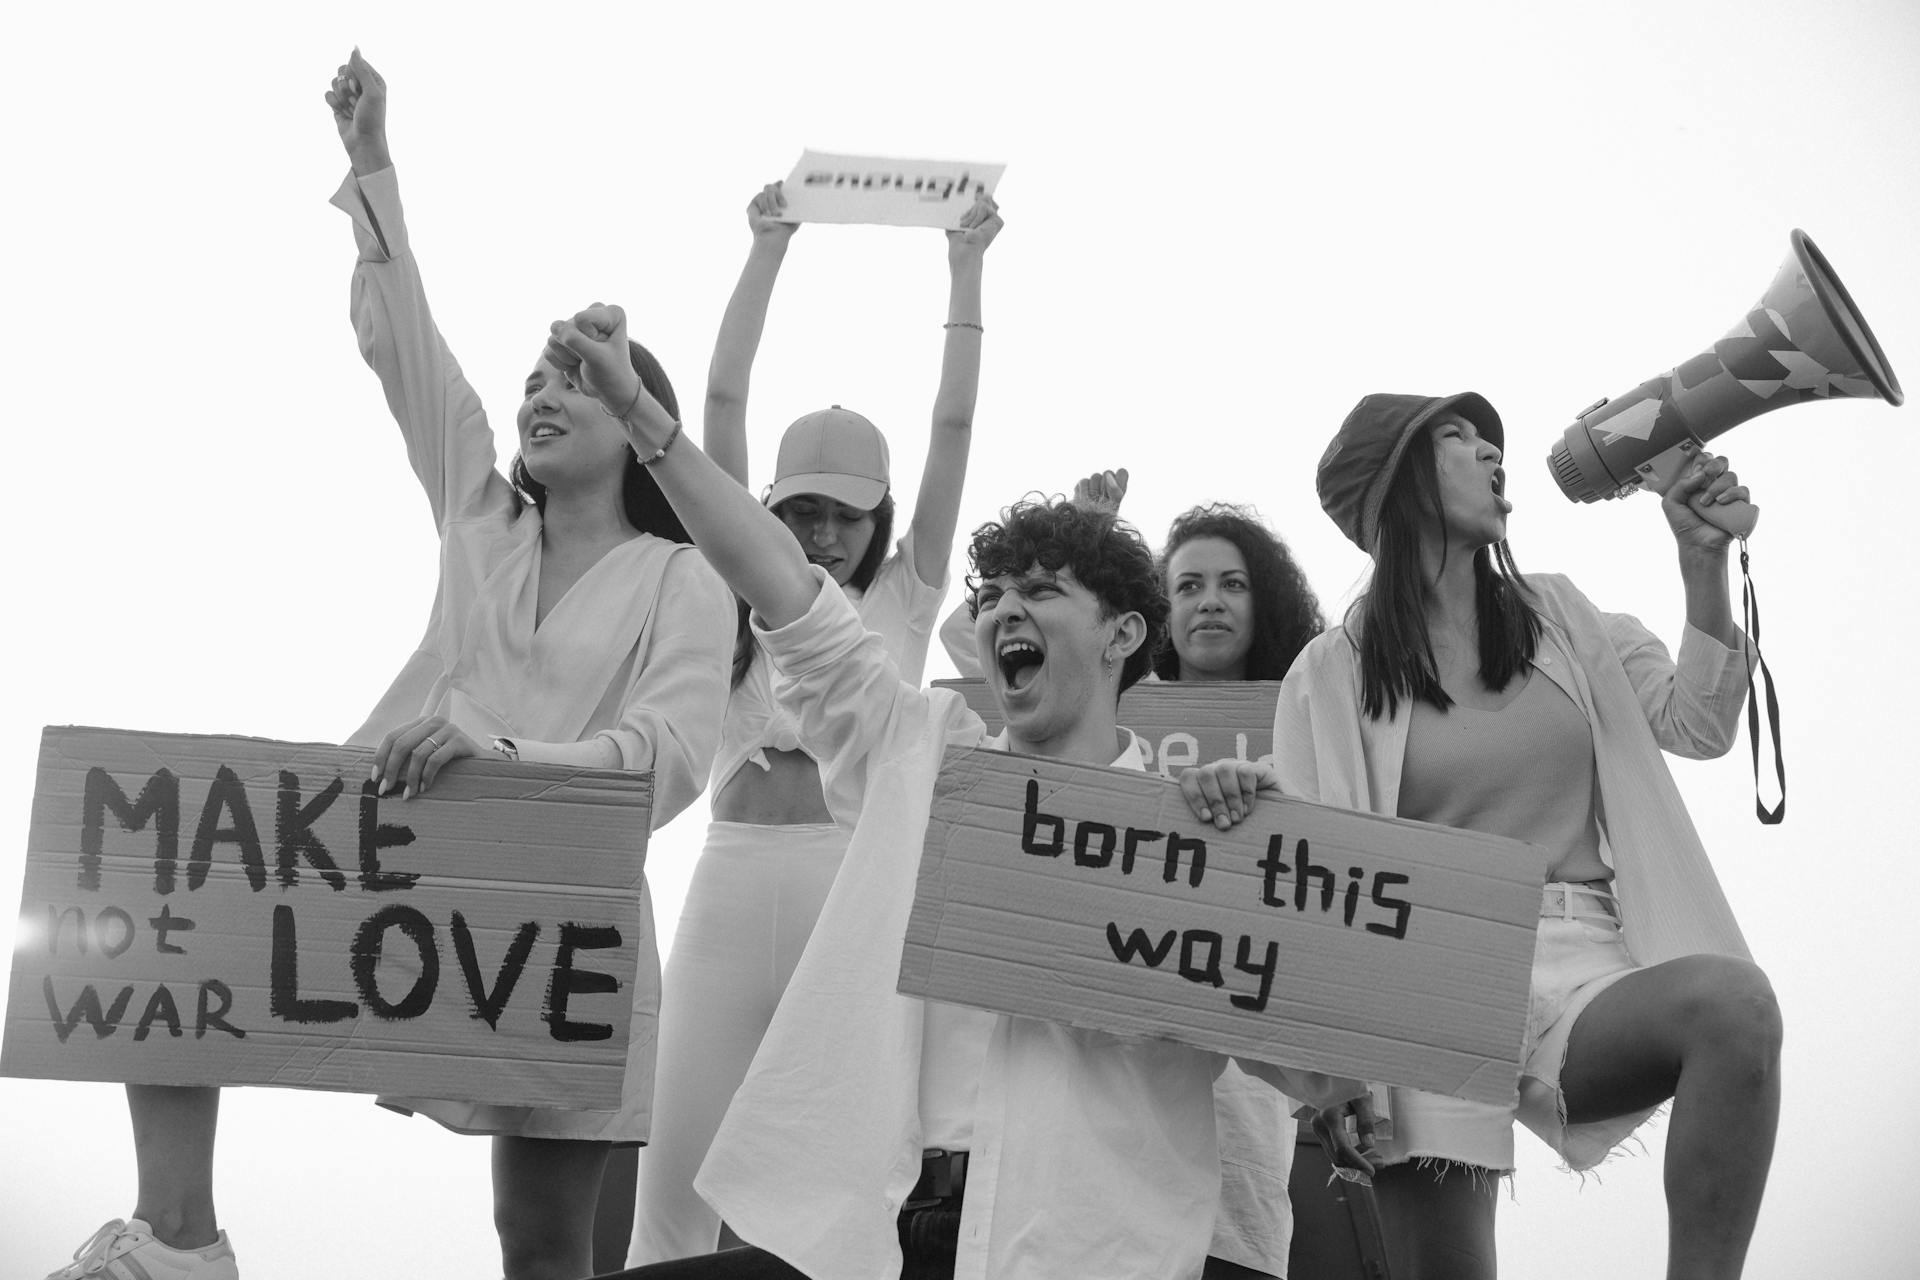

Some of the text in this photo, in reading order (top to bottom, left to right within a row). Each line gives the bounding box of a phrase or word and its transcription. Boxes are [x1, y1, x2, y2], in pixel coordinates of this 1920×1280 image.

[804, 171, 985, 202] enough
[78, 764, 421, 894] MAKE
[1021, 779, 1412, 940] born this
[48, 904, 195, 959] not
[271, 904, 623, 1042] LOVE
[1106, 921, 1280, 1012] way
[43, 975, 246, 1043] WAR
